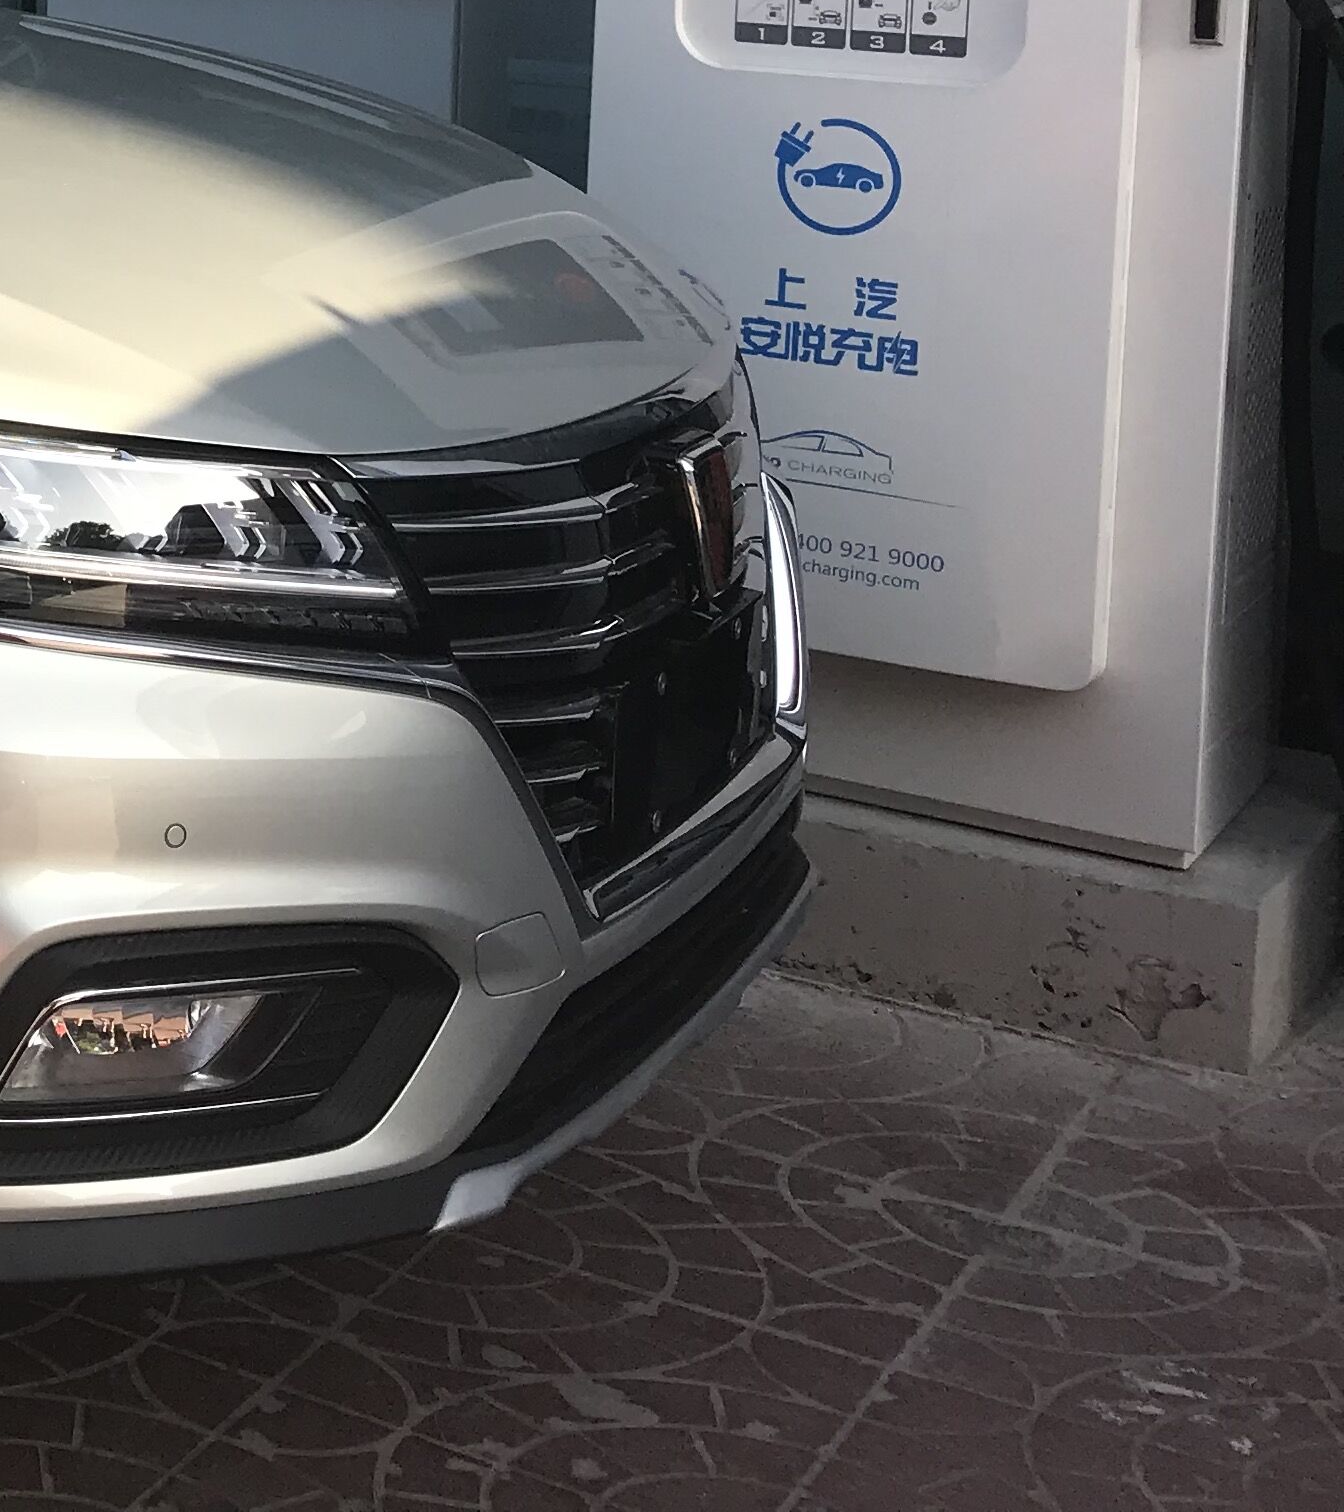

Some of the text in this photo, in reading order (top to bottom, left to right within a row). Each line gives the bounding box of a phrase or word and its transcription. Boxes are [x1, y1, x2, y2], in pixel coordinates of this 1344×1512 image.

[758, 28, 766, 41] 1
[811, 31, 826, 45] 2
[869, 35, 885, 50] 3
[929, 39, 947, 54] 4
[740, 315, 920, 377] 安悦充电
[787, 459, 893, 486] CHARGING
[840, 540, 880, 563] 921
[888, 548, 945, 574] 9000
